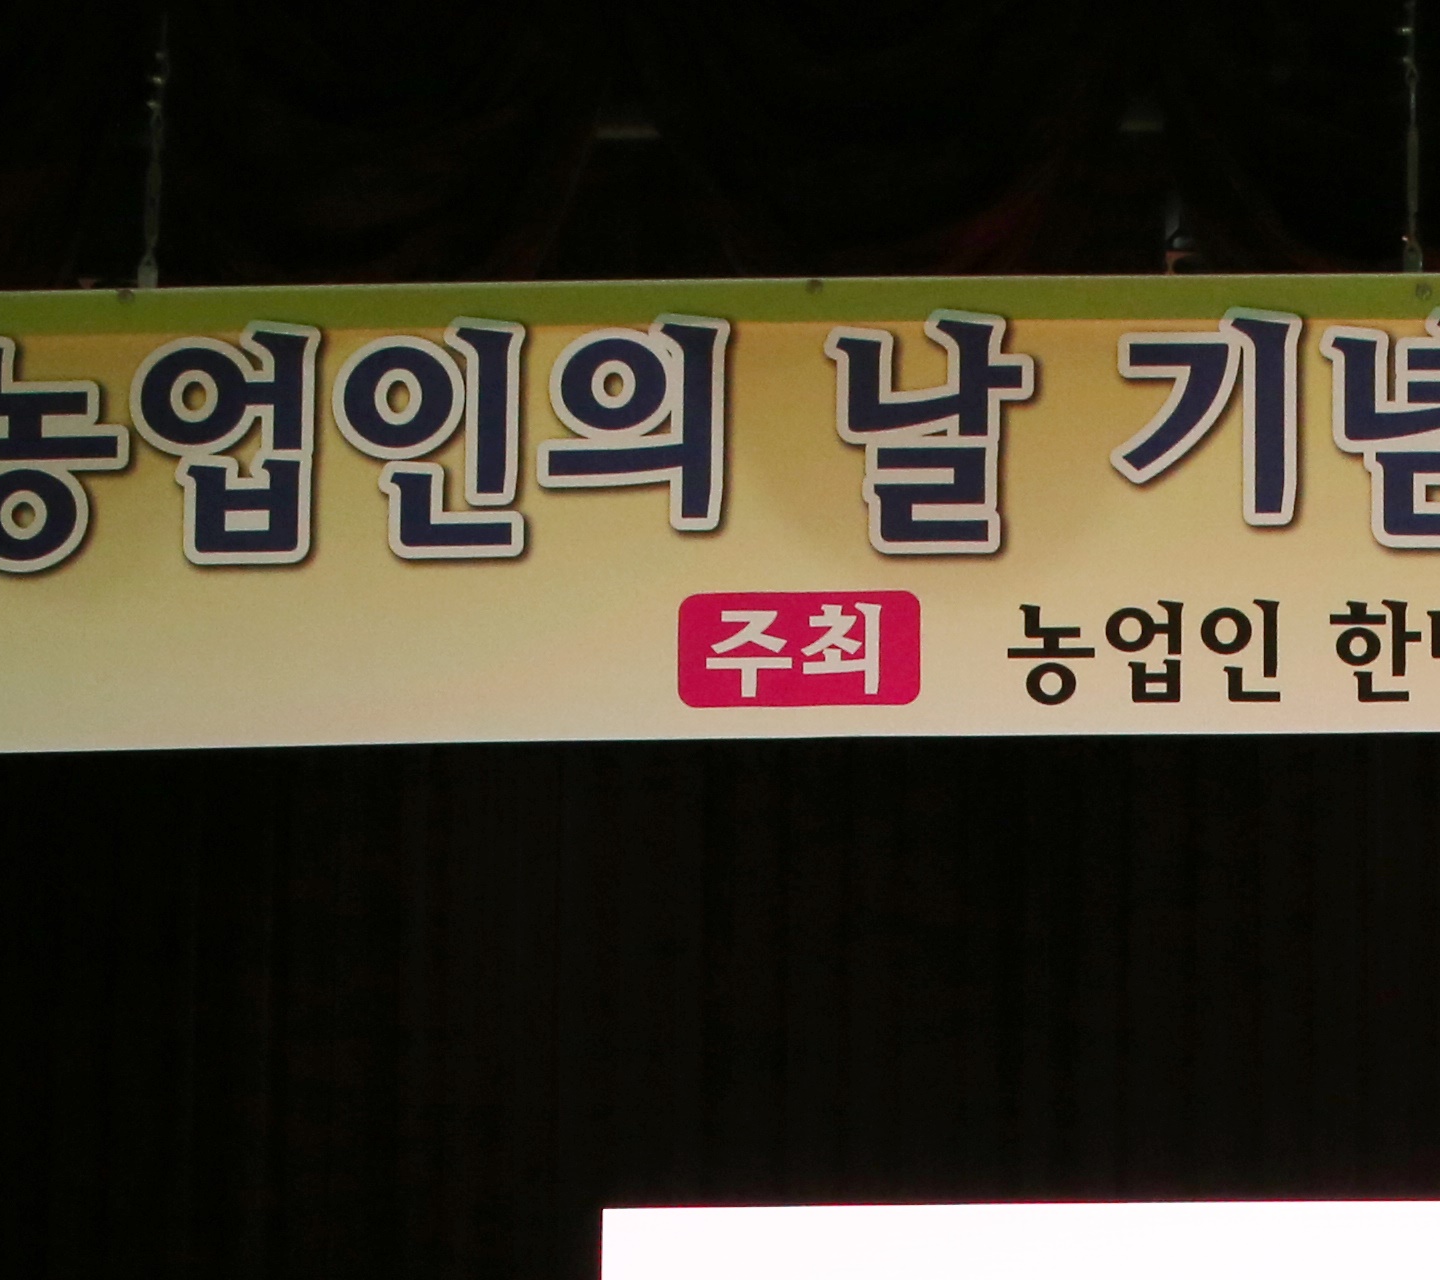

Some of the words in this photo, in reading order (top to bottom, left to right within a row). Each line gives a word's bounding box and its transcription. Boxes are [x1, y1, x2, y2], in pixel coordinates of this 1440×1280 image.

[826, 309, 1035, 554] 날
[704, 602, 883, 698] 주최
[1006, 598, 1281, 706] 농업인
